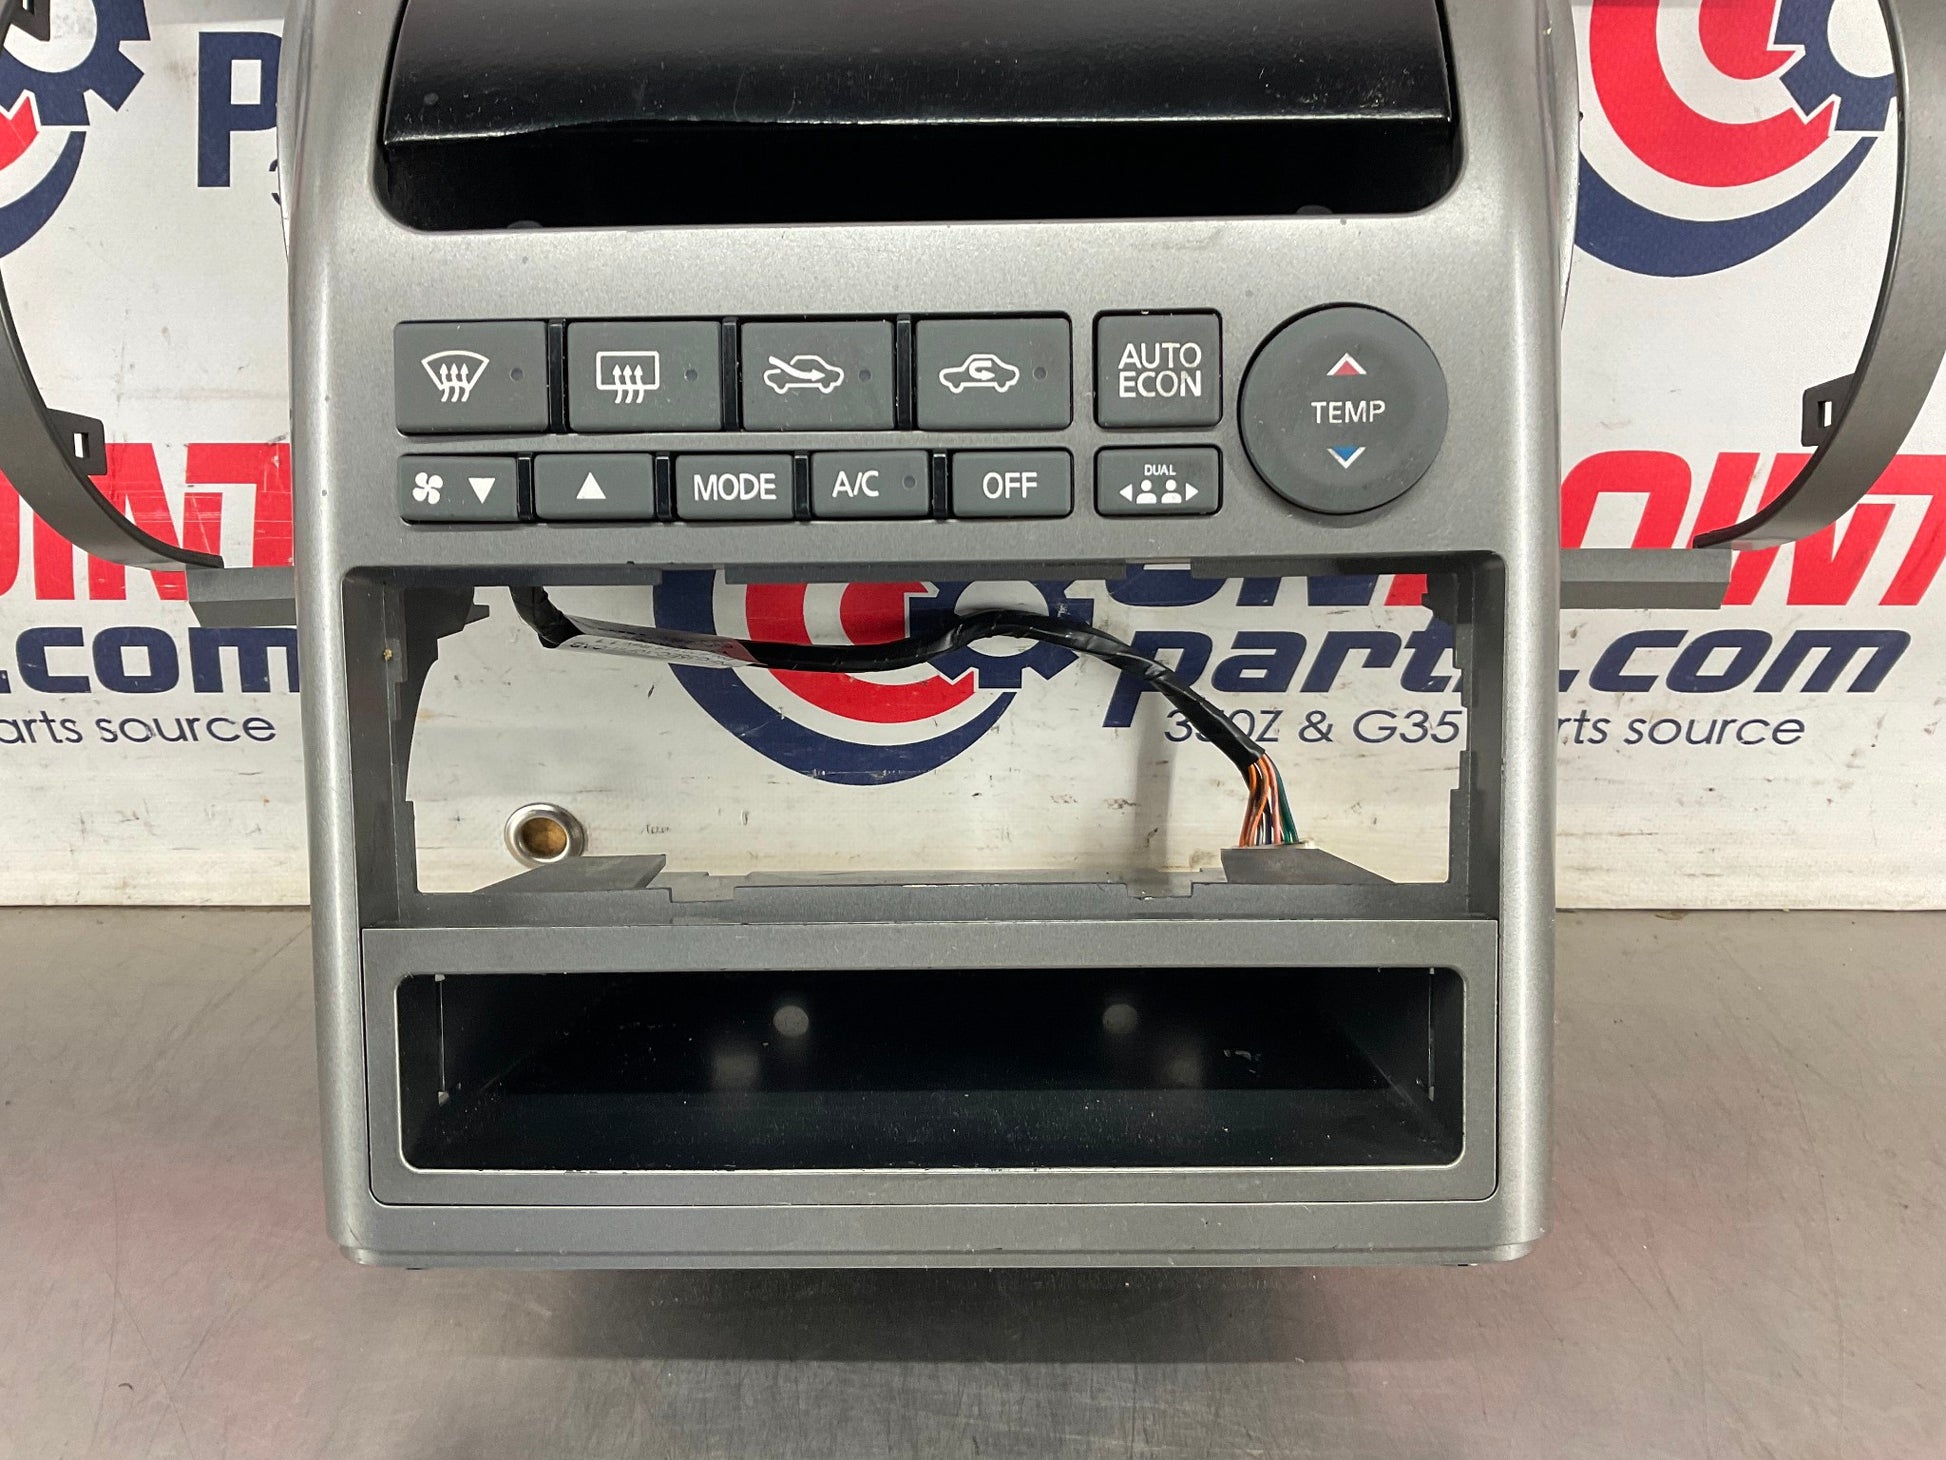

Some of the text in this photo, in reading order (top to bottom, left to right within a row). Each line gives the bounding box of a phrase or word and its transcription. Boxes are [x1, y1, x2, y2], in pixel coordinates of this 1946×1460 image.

[1118, 342, 1202, 370] AUTO
[1118, 369, 1202, 398] ECON
[1311, 400, 1386, 424] TEMP
[832, 470, 880, 498] A/C
[1144, 464, 1177, 476] DUAL
[694, 473, 777, 501] MODE
[982, 472, 1038, 499] OFF
[95, 717, 277, 743] source
[1164, 708, 1806, 745] 30Z & G35 rts source
